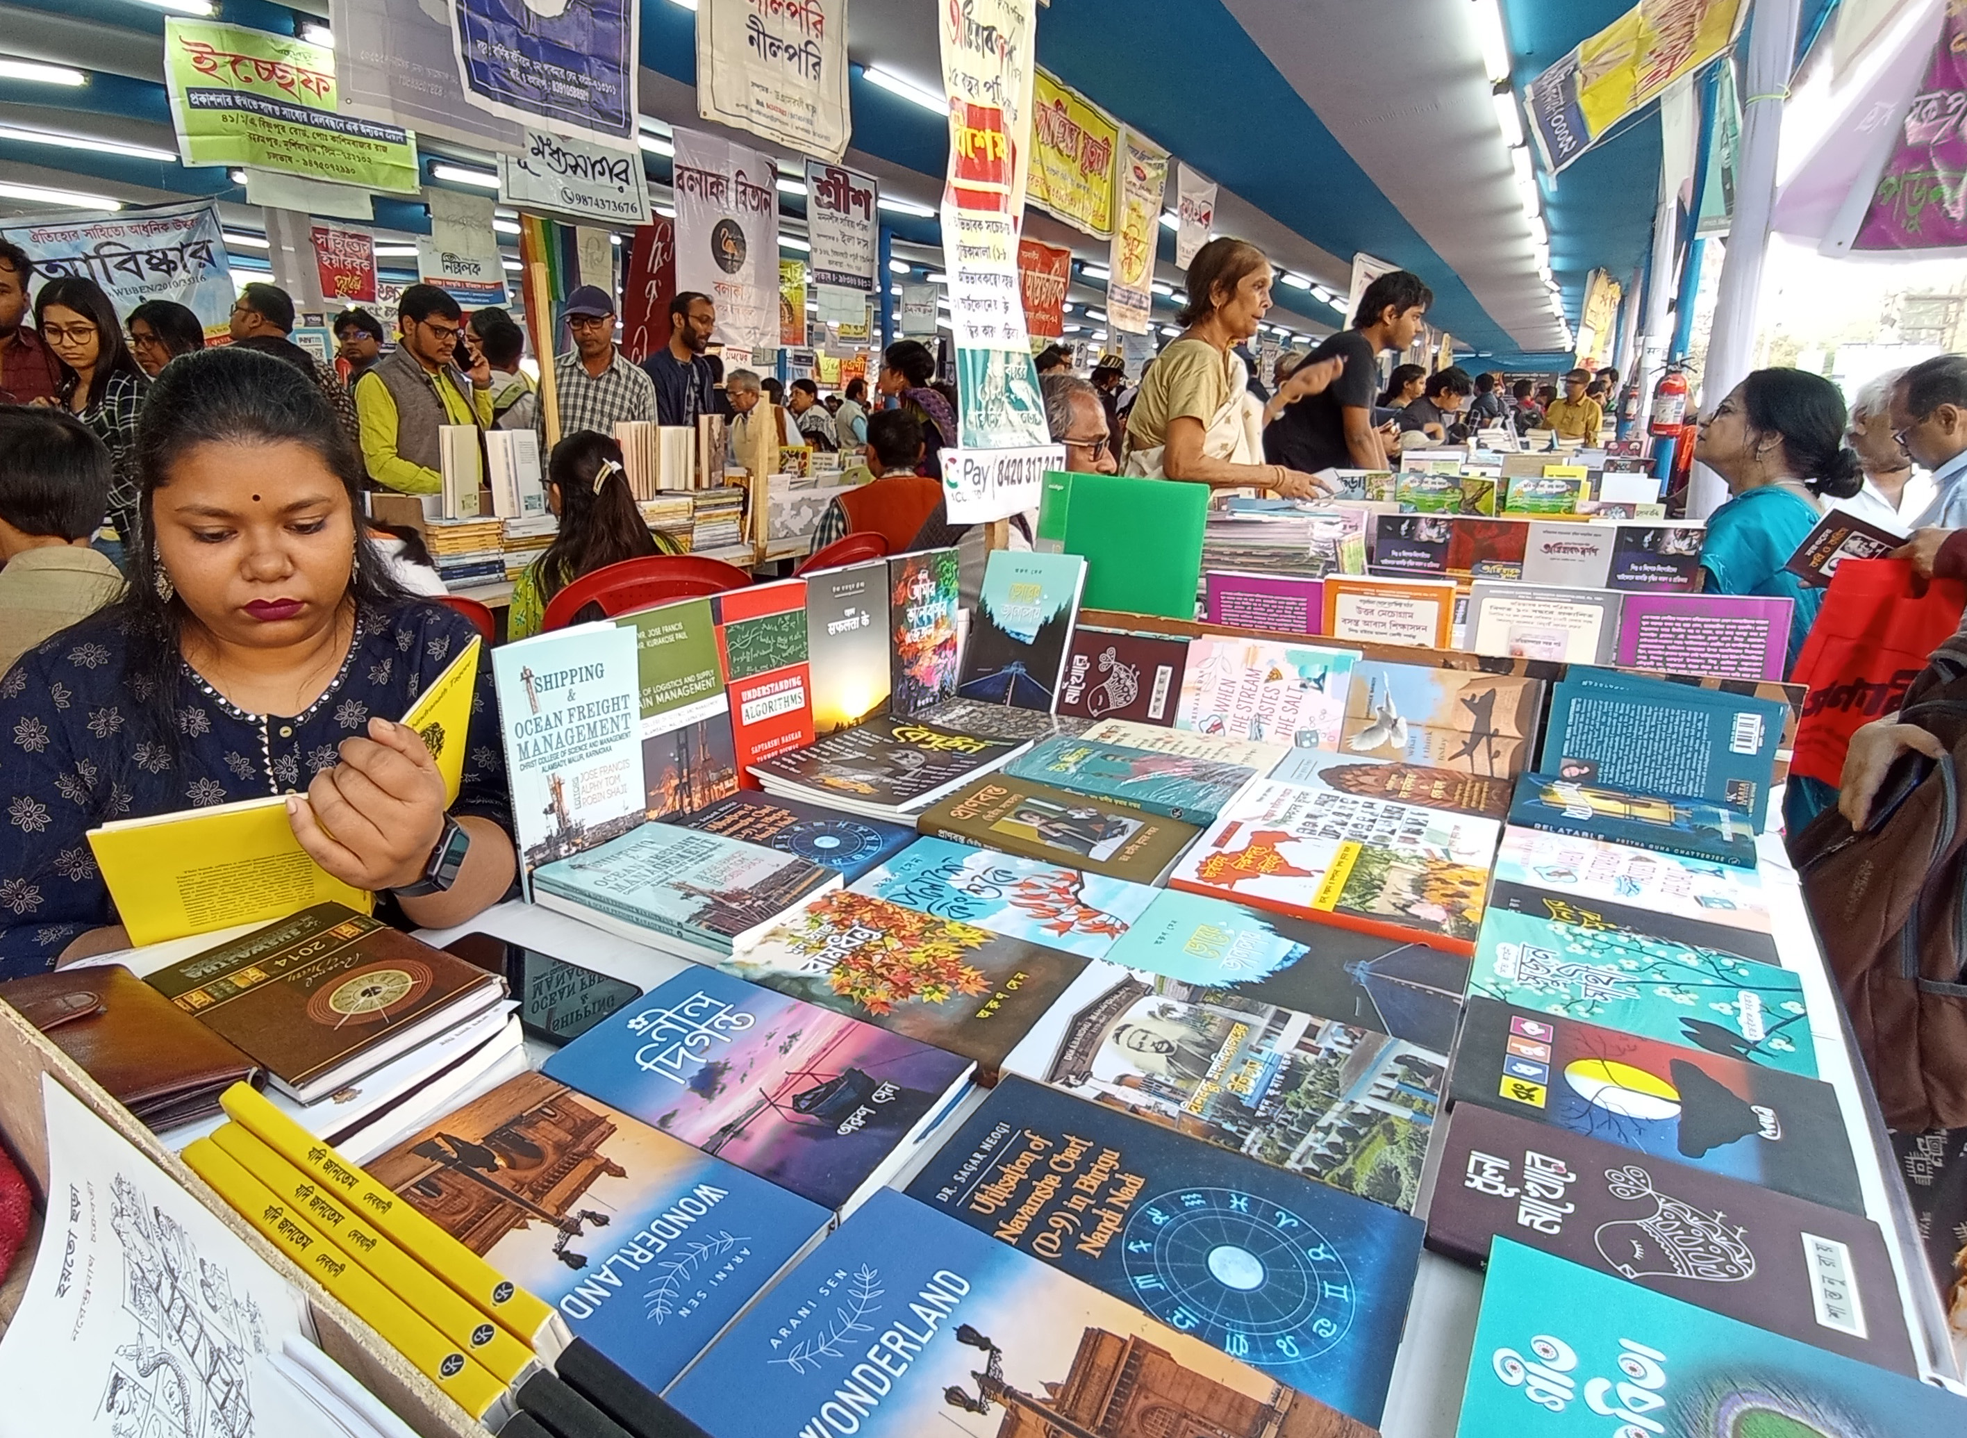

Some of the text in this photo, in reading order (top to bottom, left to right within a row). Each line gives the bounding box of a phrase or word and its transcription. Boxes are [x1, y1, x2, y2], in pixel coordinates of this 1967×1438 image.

[745, 14, 823, 81] নীলপরি
[951, 110, 1008, 162] বিশেষ
[575, 193, 638, 214] 9874373676
[811, 168, 873, 221] শ্রীশ
[127, 221, 170, 238] আধুনিক
[963, 455, 1043, 494] Pay 8420 317
[648, 622, 683, 638] JOSE FRANCIS
[828, 611, 871, 637] सफलता के
[1355, 605, 1375, 616] উত্তর
[676, 632, 688, 641] PAUL
[535, 663, 604, 693] SHIPPING
[567, 689, 576, 702] &
[652, 680, 682, 694] LOGISTICS
[684, 674, 695, 685] AND
[696, 669, 714, 682] SUPPLY
[656, 676, 716, 707] MANAGEMENT
[741, 676, 802, 702] UNDERSTANDING
[1213, 678, 1237, 713] WHEN
[515, 694, 631, 739] OCEAN FREIGHT
[744, 691, 803, 721] ALGORITHMS
[1230, 668, 1262, 735] THE STREAM
[1260, 687, 1281, 726] TASTES
[1275, 685, 1304, 738] THE SALT
[517, 713, 632, 761] MANAGEMENT
[520, 759, 538, 771] CHRIST
[538, 753, 561, 766] COLLEGE
[567, 746, 588, 757] SCIENCE
[588, 741, 599, 751] AND
[599, 731, 632, 747] MANAGEMENT
[751, 731, 802, 755] SAPTARSHI NASKAR
[580, 758, 631, 783] JOSE FRANCIS
[581, 773, 620, 795] ALPHY TOM
[582, 783, 628, 807] ROBIN SHAJI
[950, 784, 1008, 820] প্রাণবন্ত
[594, 836, 702, 887] OCEAN FREIGHT
[1534, 822, 1726, 861] RELATABLE PRITHA GUHA CHATTERJEE
[606, 839, 718, 893] MANAGEMENT
[273, 941, 326, 967] 2014
[800, 921, 889, 974] রামধনু
[976, 971, 1030, 1019] অরুণ সেন
[627, 990, 727, 1060] নীল
[635, 1005, 756, 1084] দিগন্ত
[837, 1081, 901, 1136] অরুণ সেন
[308, 1147, 393, 1215] যদি জানতেম দেবযানী
[937, 1121, 1011, 1202] DR. SAGAR NEOGI
[970, 1128, 1054, 1216] Utilisation of
[994, 1135, 1093, 1245] Navamsha Chart
[1032, 1147, 1121, 1259] (D-9) in Bhrigu
[295, 1184, 377, 1253] যদি জানতেম দেবযানী
[1075, 1173, 1146, 1259] Nandi Nadi
[263, 1205, 346, 1278] যদি জানতেম দেবযানী
[559, 1183, 728, 1320] WONDERLAND
[679, 1247, 751, 1318] ARANI SEN
[769, 1268, 848, 1350] ARANI SEN
